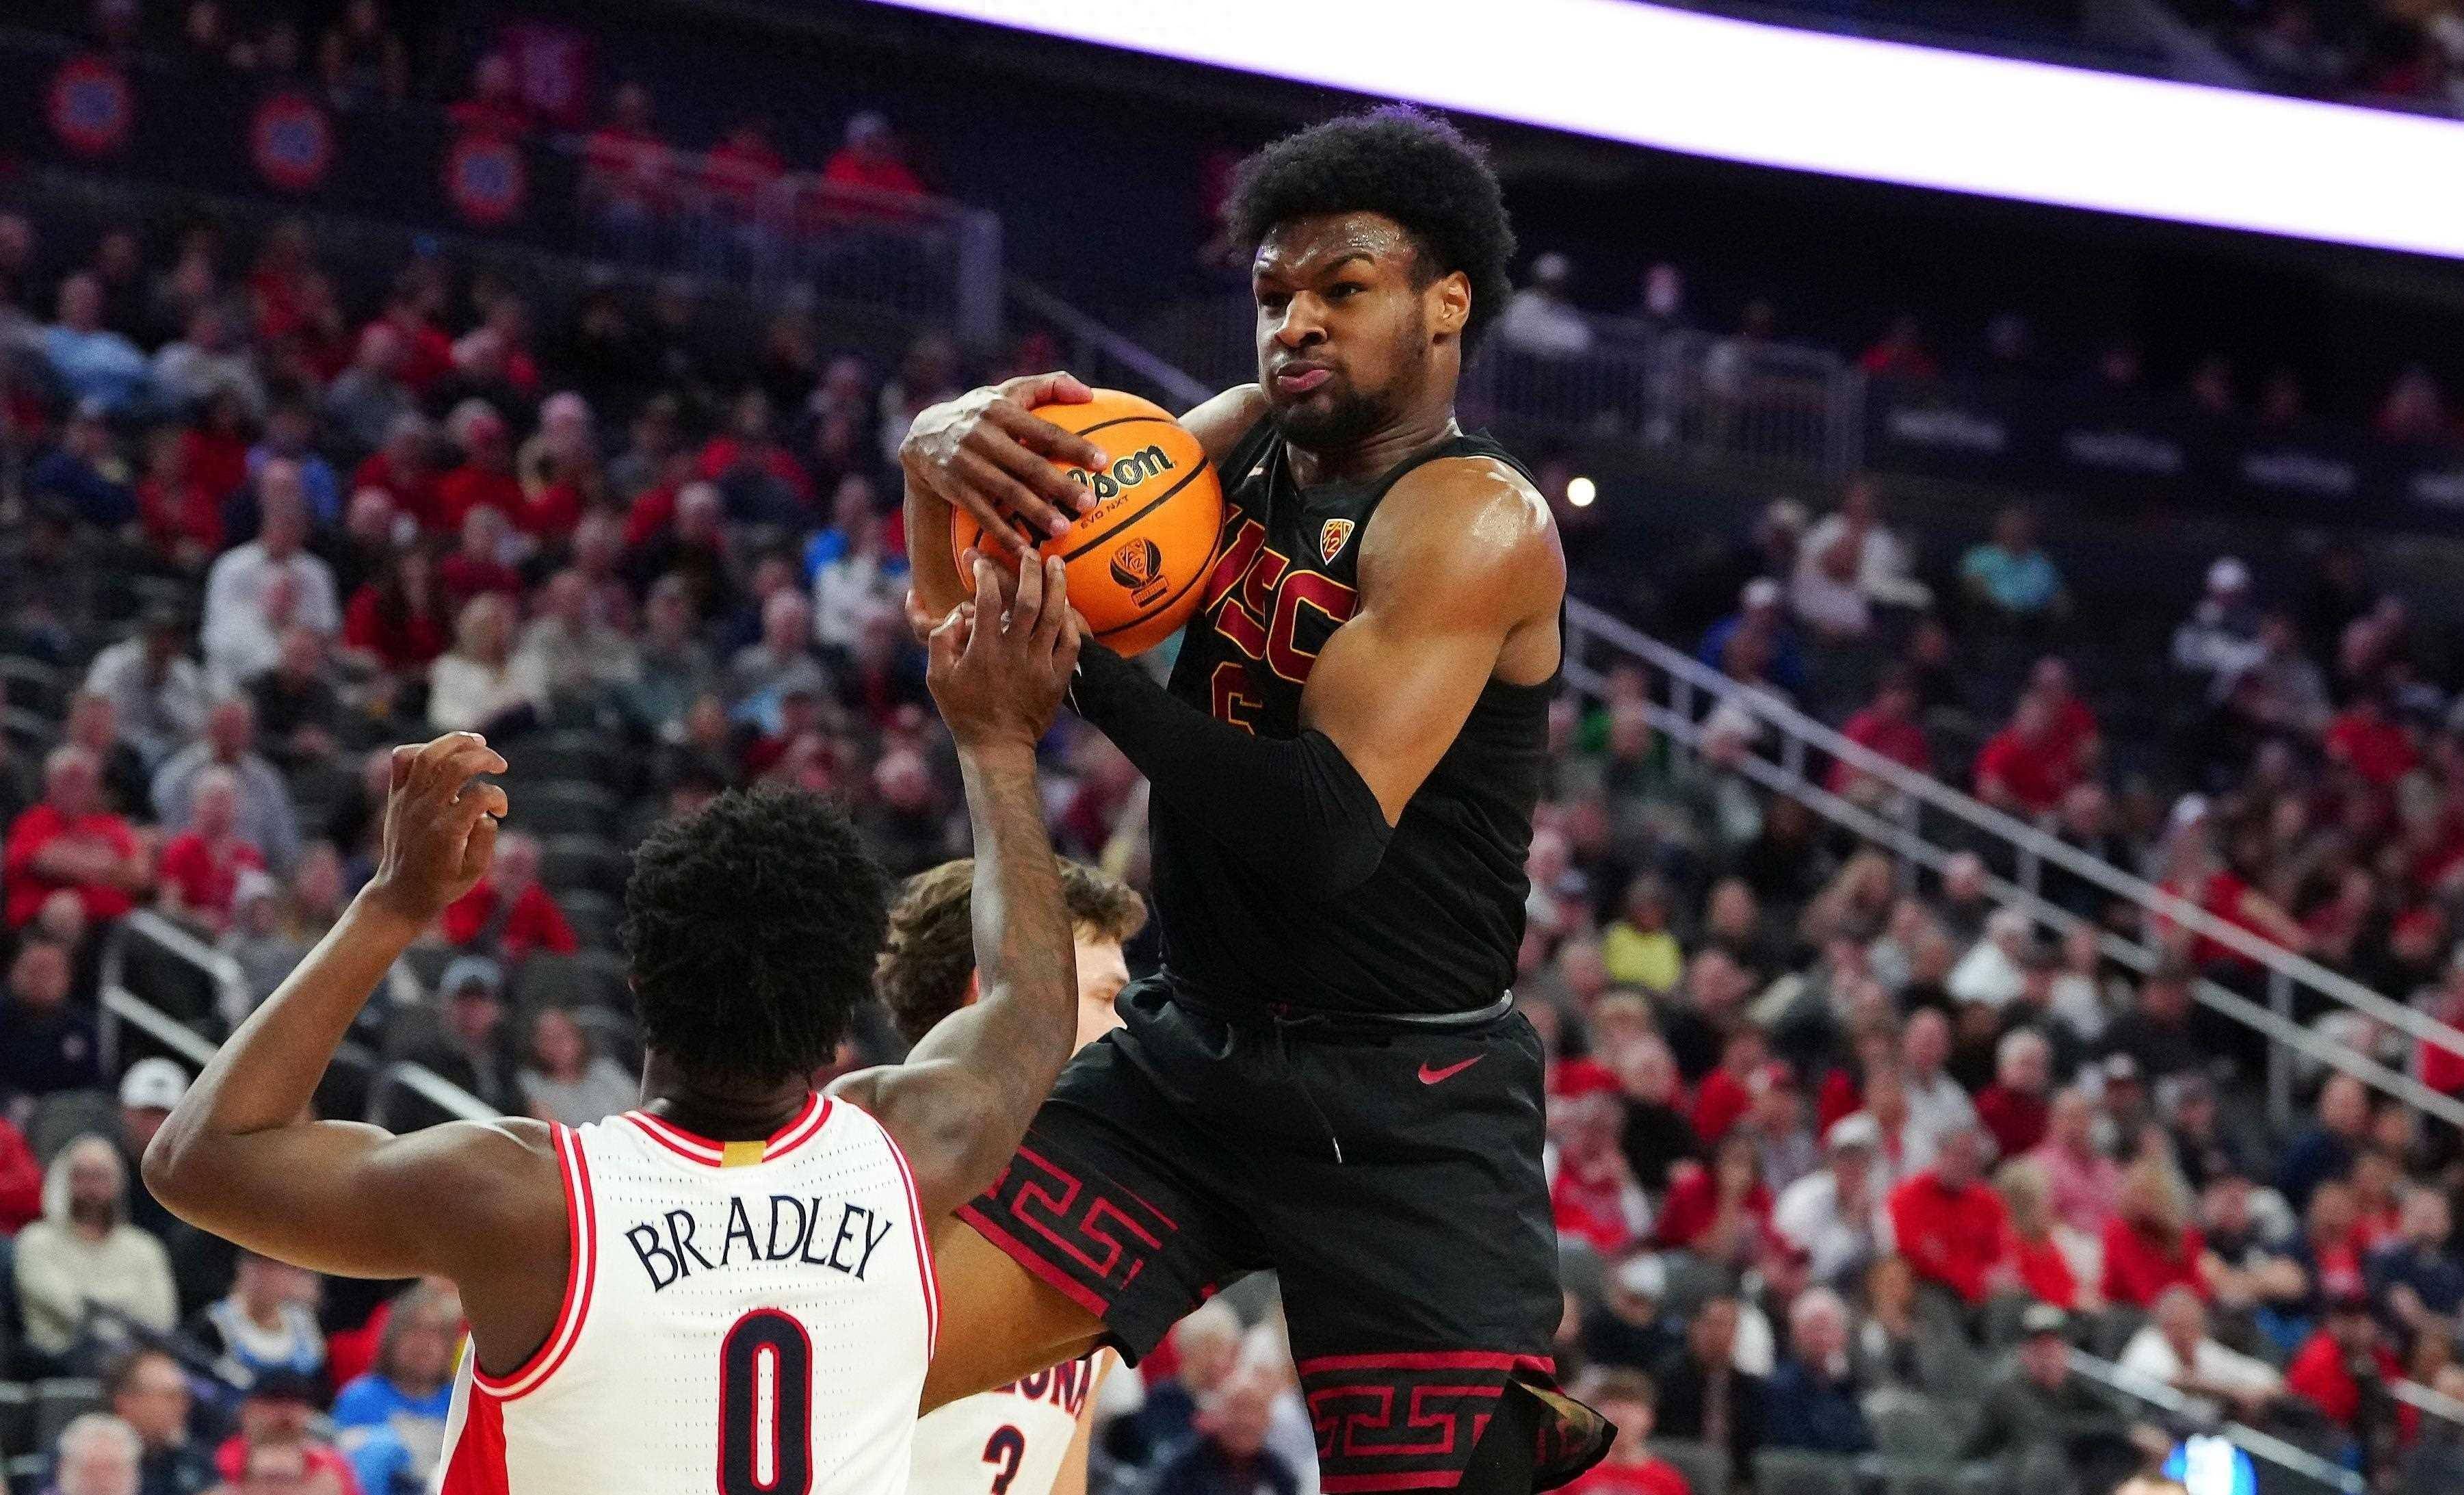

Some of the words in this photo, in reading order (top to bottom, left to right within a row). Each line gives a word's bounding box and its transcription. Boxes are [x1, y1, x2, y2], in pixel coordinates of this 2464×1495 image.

[1324, 537, 1338, 553] 12
[625, 1195, 893, 1292] BRADLEY
[717, 1308, 813, 1495] 0
